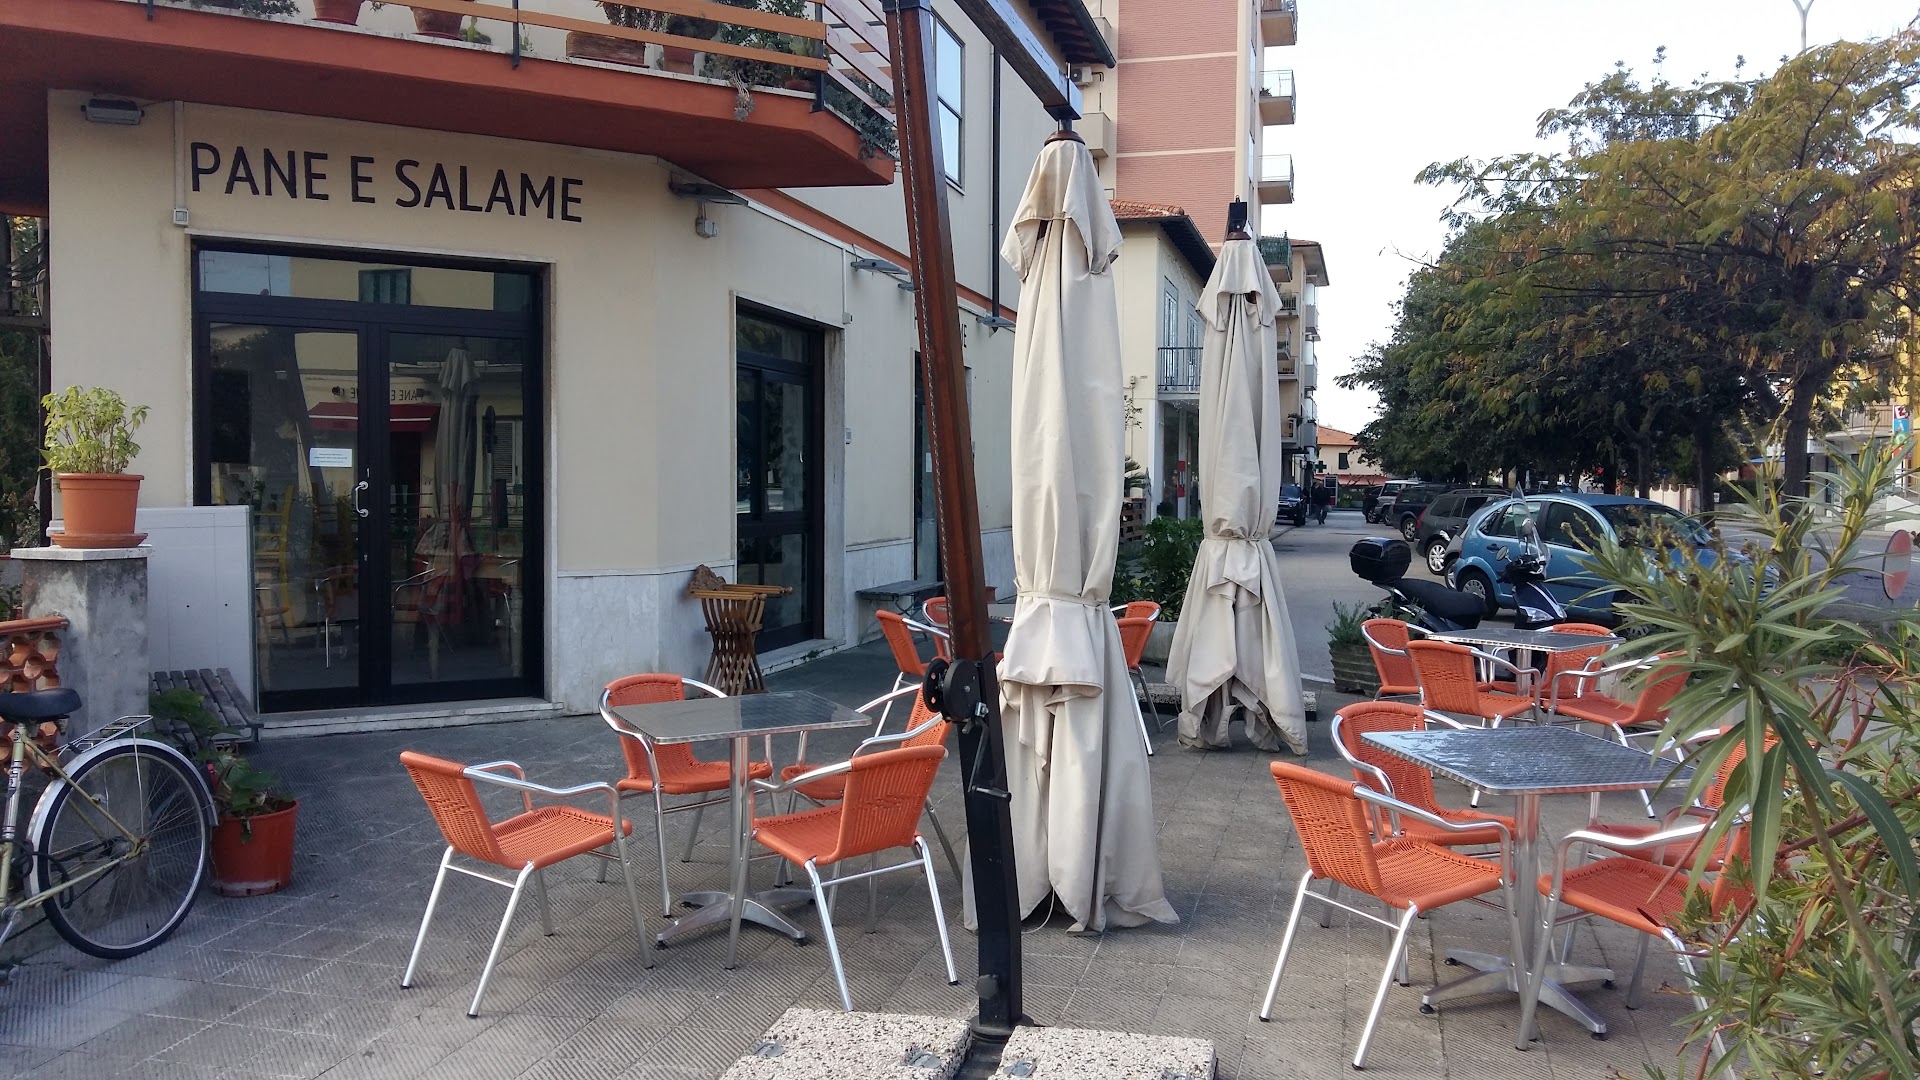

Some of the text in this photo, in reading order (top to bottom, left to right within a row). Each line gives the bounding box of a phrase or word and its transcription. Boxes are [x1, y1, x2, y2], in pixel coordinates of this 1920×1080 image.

[190, 142, 584, 223] PANE E SALAME
